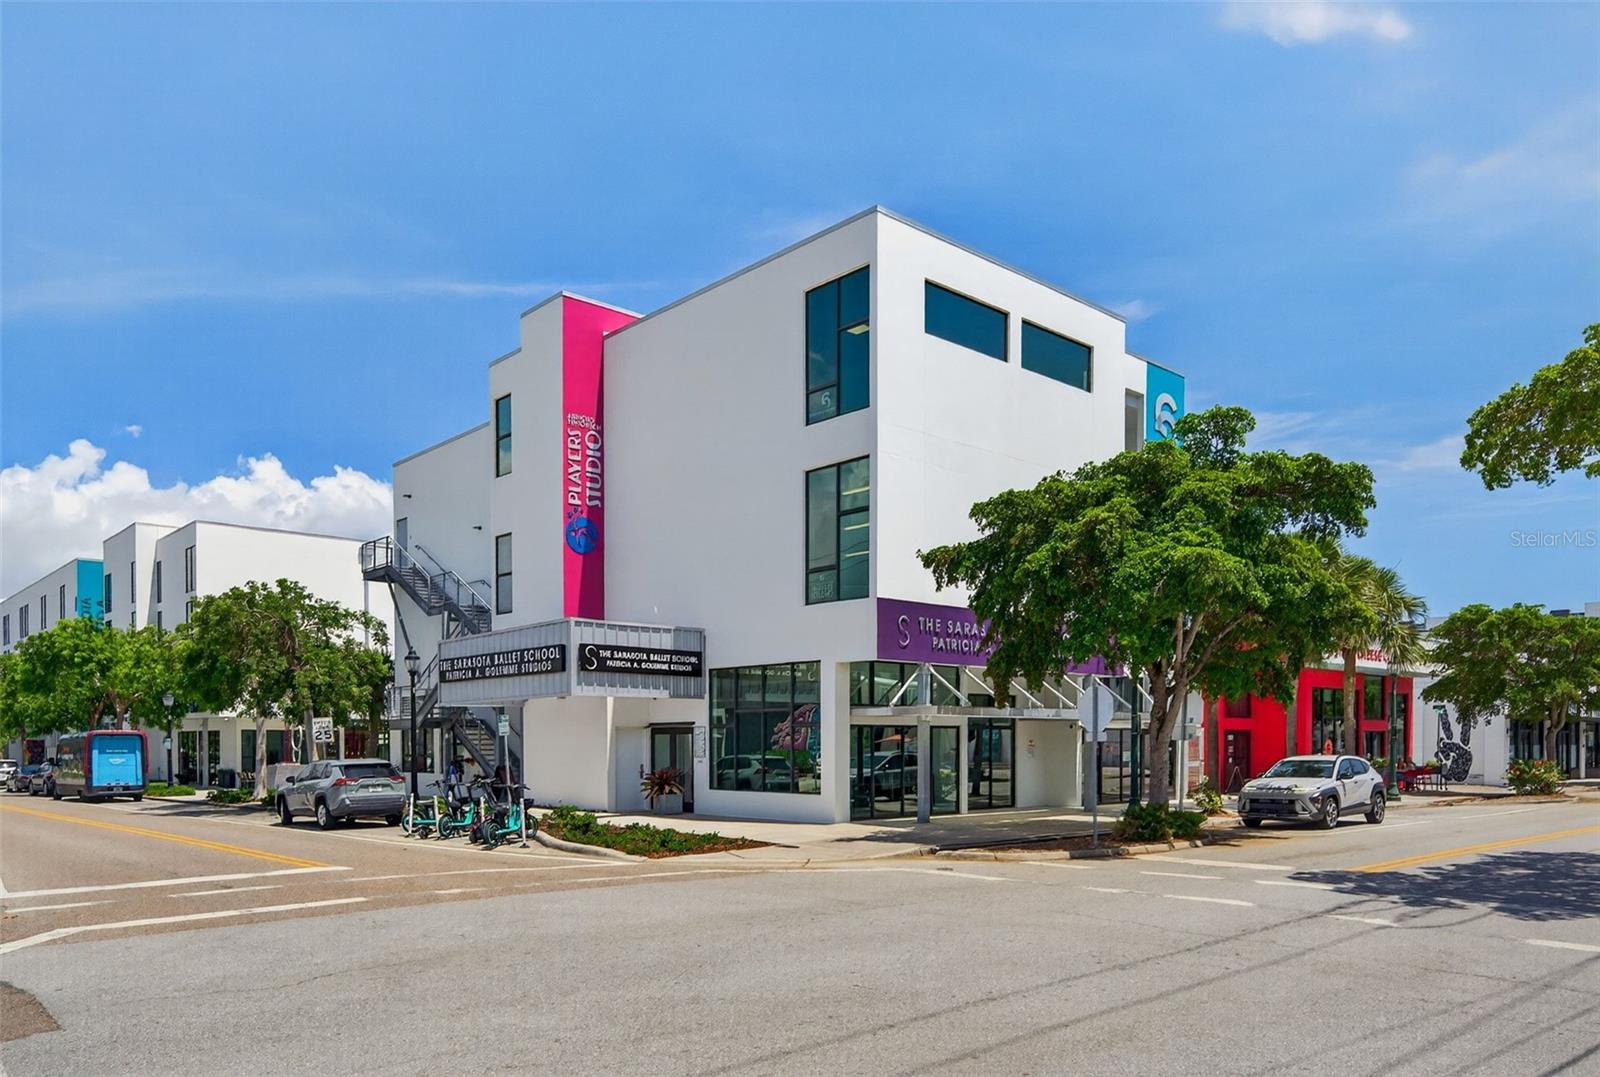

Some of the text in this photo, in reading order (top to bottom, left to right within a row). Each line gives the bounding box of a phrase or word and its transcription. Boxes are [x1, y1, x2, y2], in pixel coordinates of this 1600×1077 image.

[567, 428, 582, 506] PLAYERS
[585, 430, 602, 507] STUDIO
[918, 617, 986, 637] THE SARAS
[439, 646, 560, 672] THE SARASOTA BALLET SCHOOL
[599, 649, 612, 658] THE
[613, 650, 648, 661] SARASOTA
[521, 660, 552, 673] STUDIOS
[315, 730, 332, 741] 25
